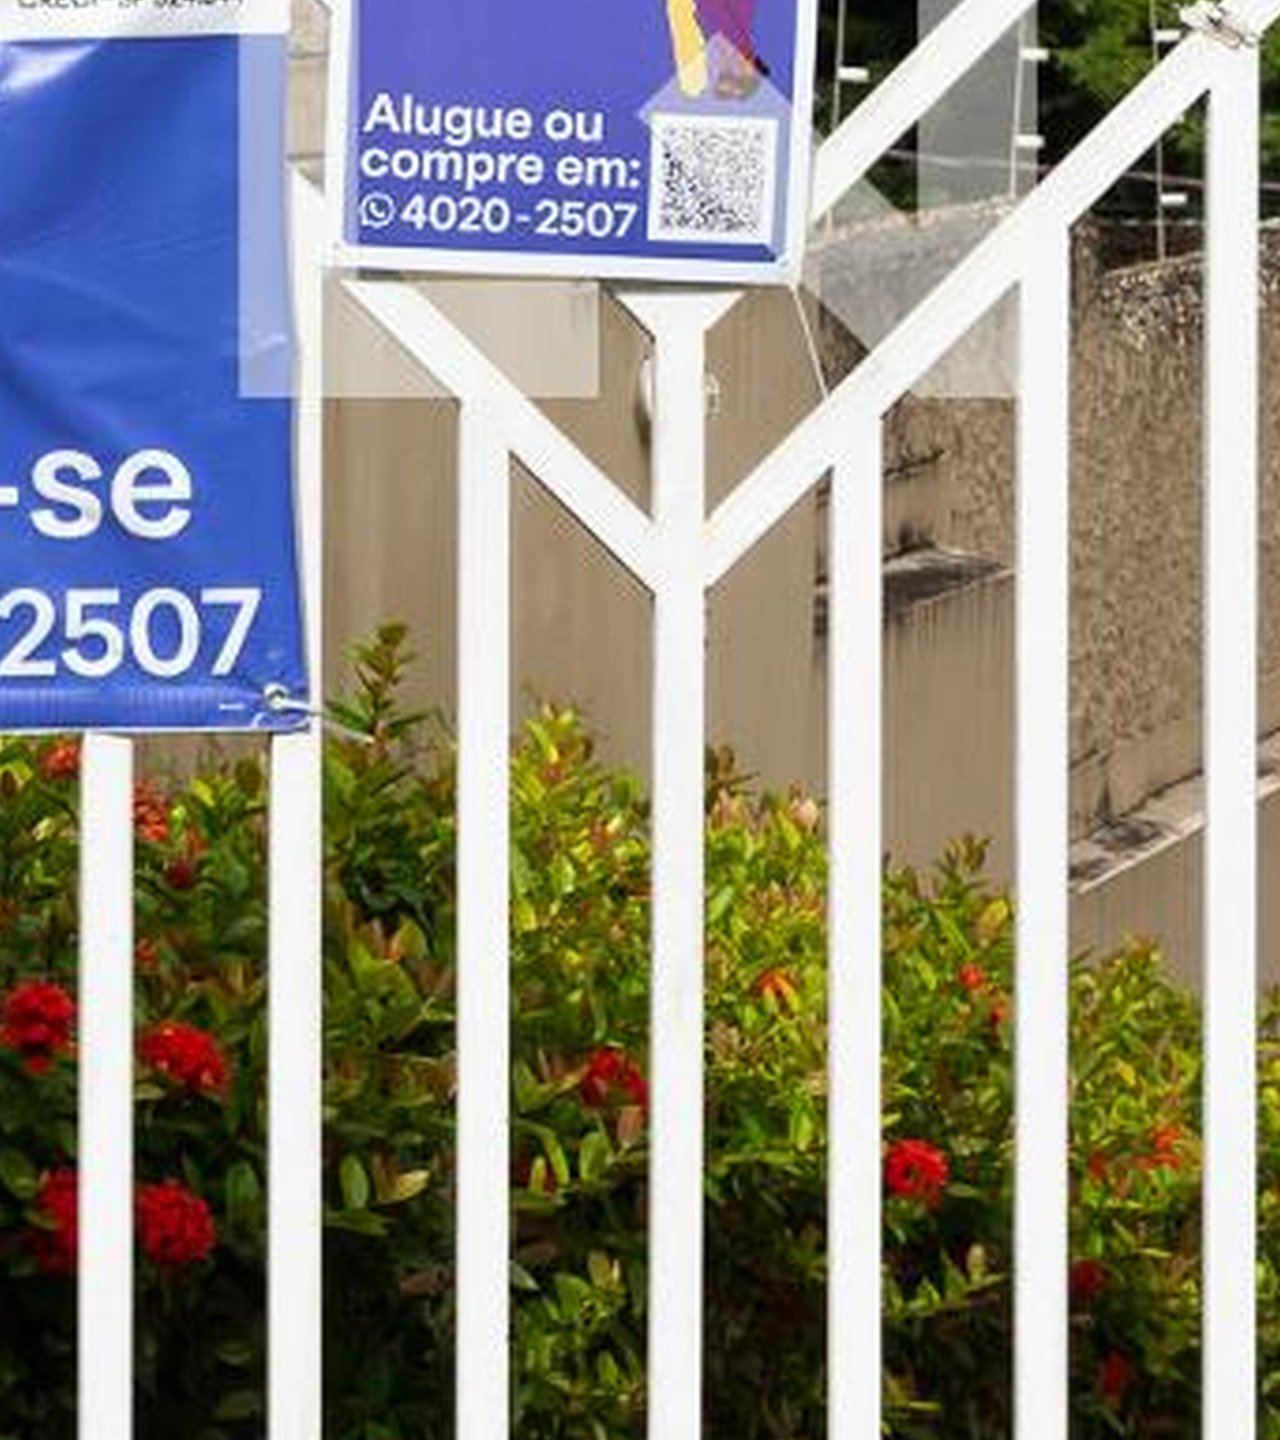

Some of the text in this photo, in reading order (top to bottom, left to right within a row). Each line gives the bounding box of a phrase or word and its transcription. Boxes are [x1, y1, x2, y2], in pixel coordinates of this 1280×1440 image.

[362, 92, 605, 147] Alugue ou
[360, 146, 641, 191] compre em:
